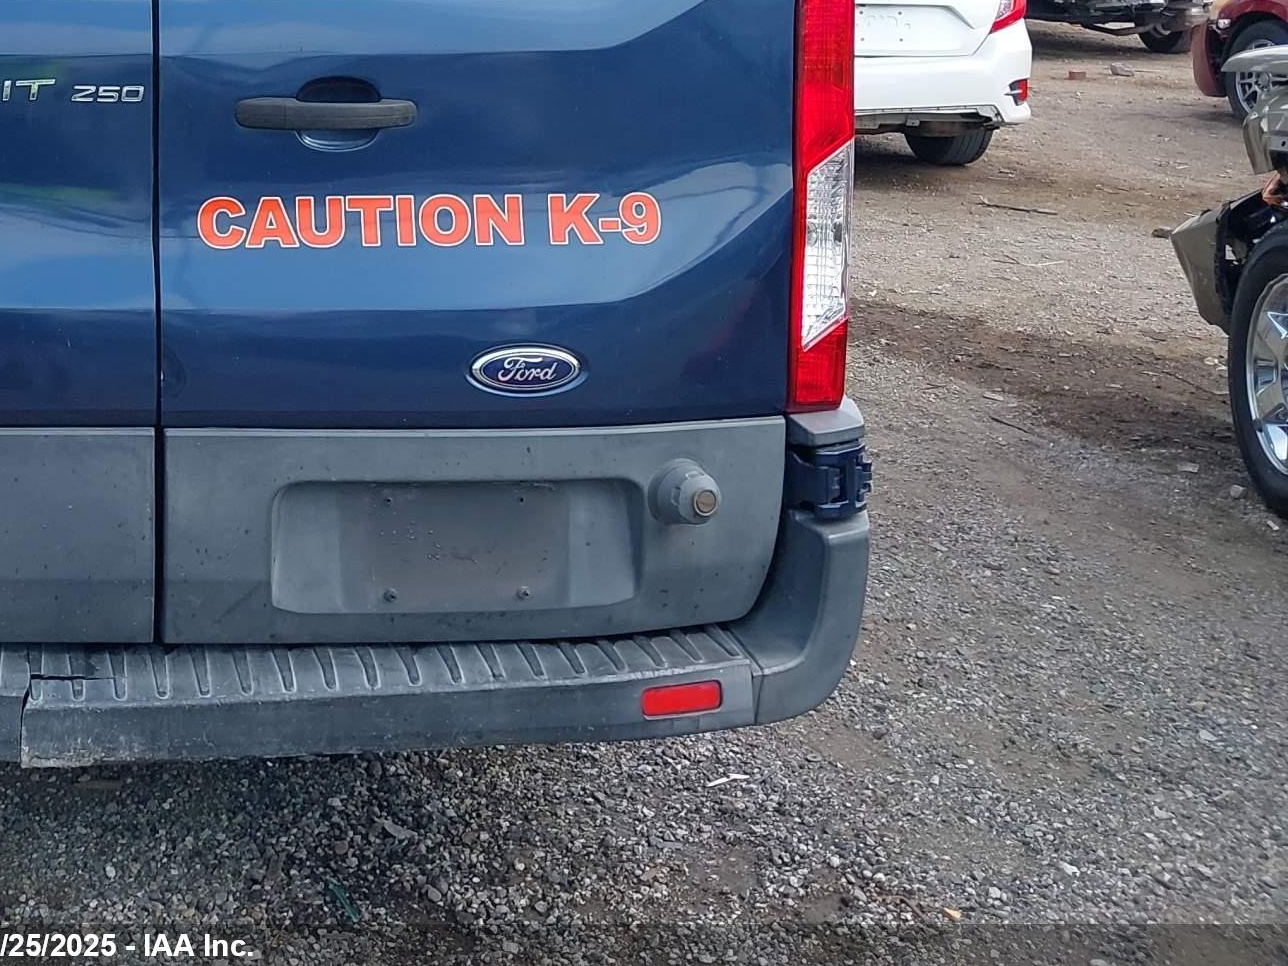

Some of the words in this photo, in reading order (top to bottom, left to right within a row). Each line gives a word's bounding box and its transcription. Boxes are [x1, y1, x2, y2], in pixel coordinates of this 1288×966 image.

[71, 85, 145, 102] 250
[197, 193, 522, 249] CAUTION
[548, 192, 661, 246] K-9
[497, 356, 557, 383] Ford
